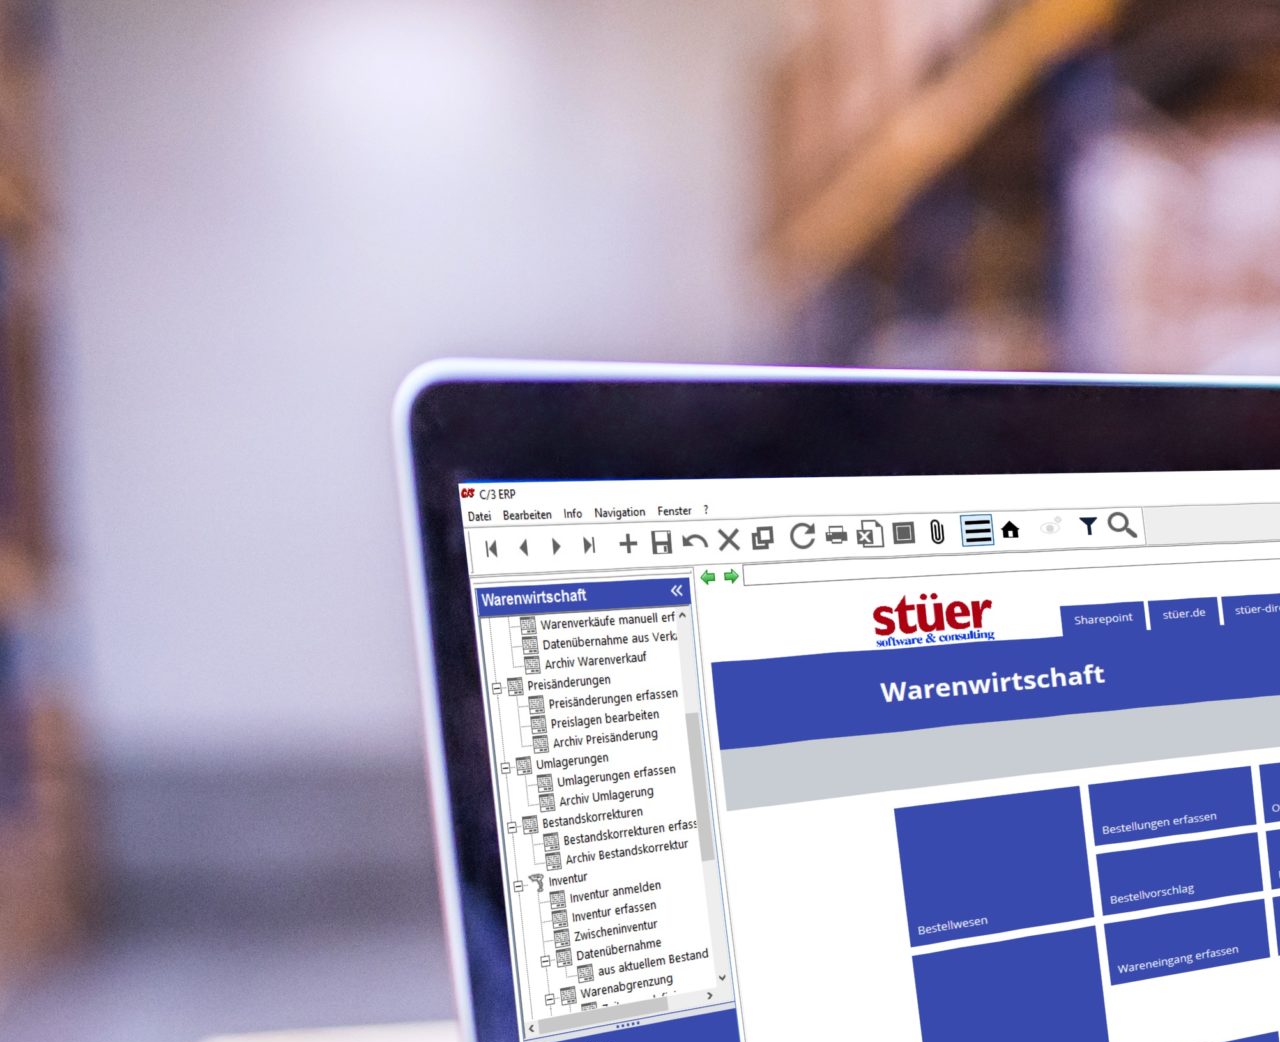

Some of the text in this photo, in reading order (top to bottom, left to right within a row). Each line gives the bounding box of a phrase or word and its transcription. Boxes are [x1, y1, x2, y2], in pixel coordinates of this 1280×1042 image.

[479, 489, 516, 500] C/3 ERP
[468, 511, 492, 522] Datei
[503, 510, 552, 520] Bearbeiten
[564, 508, 582, 518] Info
[594, 507, 646, 520] Navigation
[658, 506, 692, 516] Fenster
[704, 504, 708, 514] ?
[481, 588, 587, 607] Warenwirtschaft
[540, 615, 615, 630] Warenverkäufe
[619, 612, 658, 625] manuell
[873, 593, 992, 635] stüer
[1074, 613, 1133, 626] Sharepoint
[1163, 608, 1206, 619] stüer.de
[543, 635, 628, 650] Datenübernahme
[632, 634, 649, 643] aus
[876, 630, 995, 647] software & consulting
[545, 651, 646, 669] Archiv Warenverkauf
[528, 676, 611, 691] Preisänderungen
[880, 664, 1105, 702] Warenwirtschaft
[549, 689, 678, 709] Preisänderungen erfassen
[551, 710, 659, 729] Preislagen bearbeiten
[553, 730, 658, 748] Archiv Preisänderung
[536, 754, 609, 770] Umlagerungen
[557, 766, 676, 787] Umlagerungen erfassen
[560, 788, 654, 807] Archiv Umlagerung
[542, 808, 643, 829] Bestandskorrekturen
[1102, 813, 1217, 835] Bestellungen erfassen
[564, 825, 665, 846] Bestandskorrekturen
[566, 840, 688, 865] Archiv Bestandskorrektur
[549, 873, 588, 886] Inventur
[570, 881, 661, 903] Inventur anmelden
[1110, 885, 1195, 904] Bestellvorschlag
[572, 902, 656, 922] Inventur erfassen
[574, 921, 658, 942] Zwischeninventur
[918, 917, 988, 935] Bestellwesen
[576, 939, 661, 961] Datenübernahme
[598, 948, 709, 976] aus aktuellem Bestand
[1117, 946, 1239, 974] Wareneingang erfassen
[580, 975, 673, 998] Warenabgrenzung
